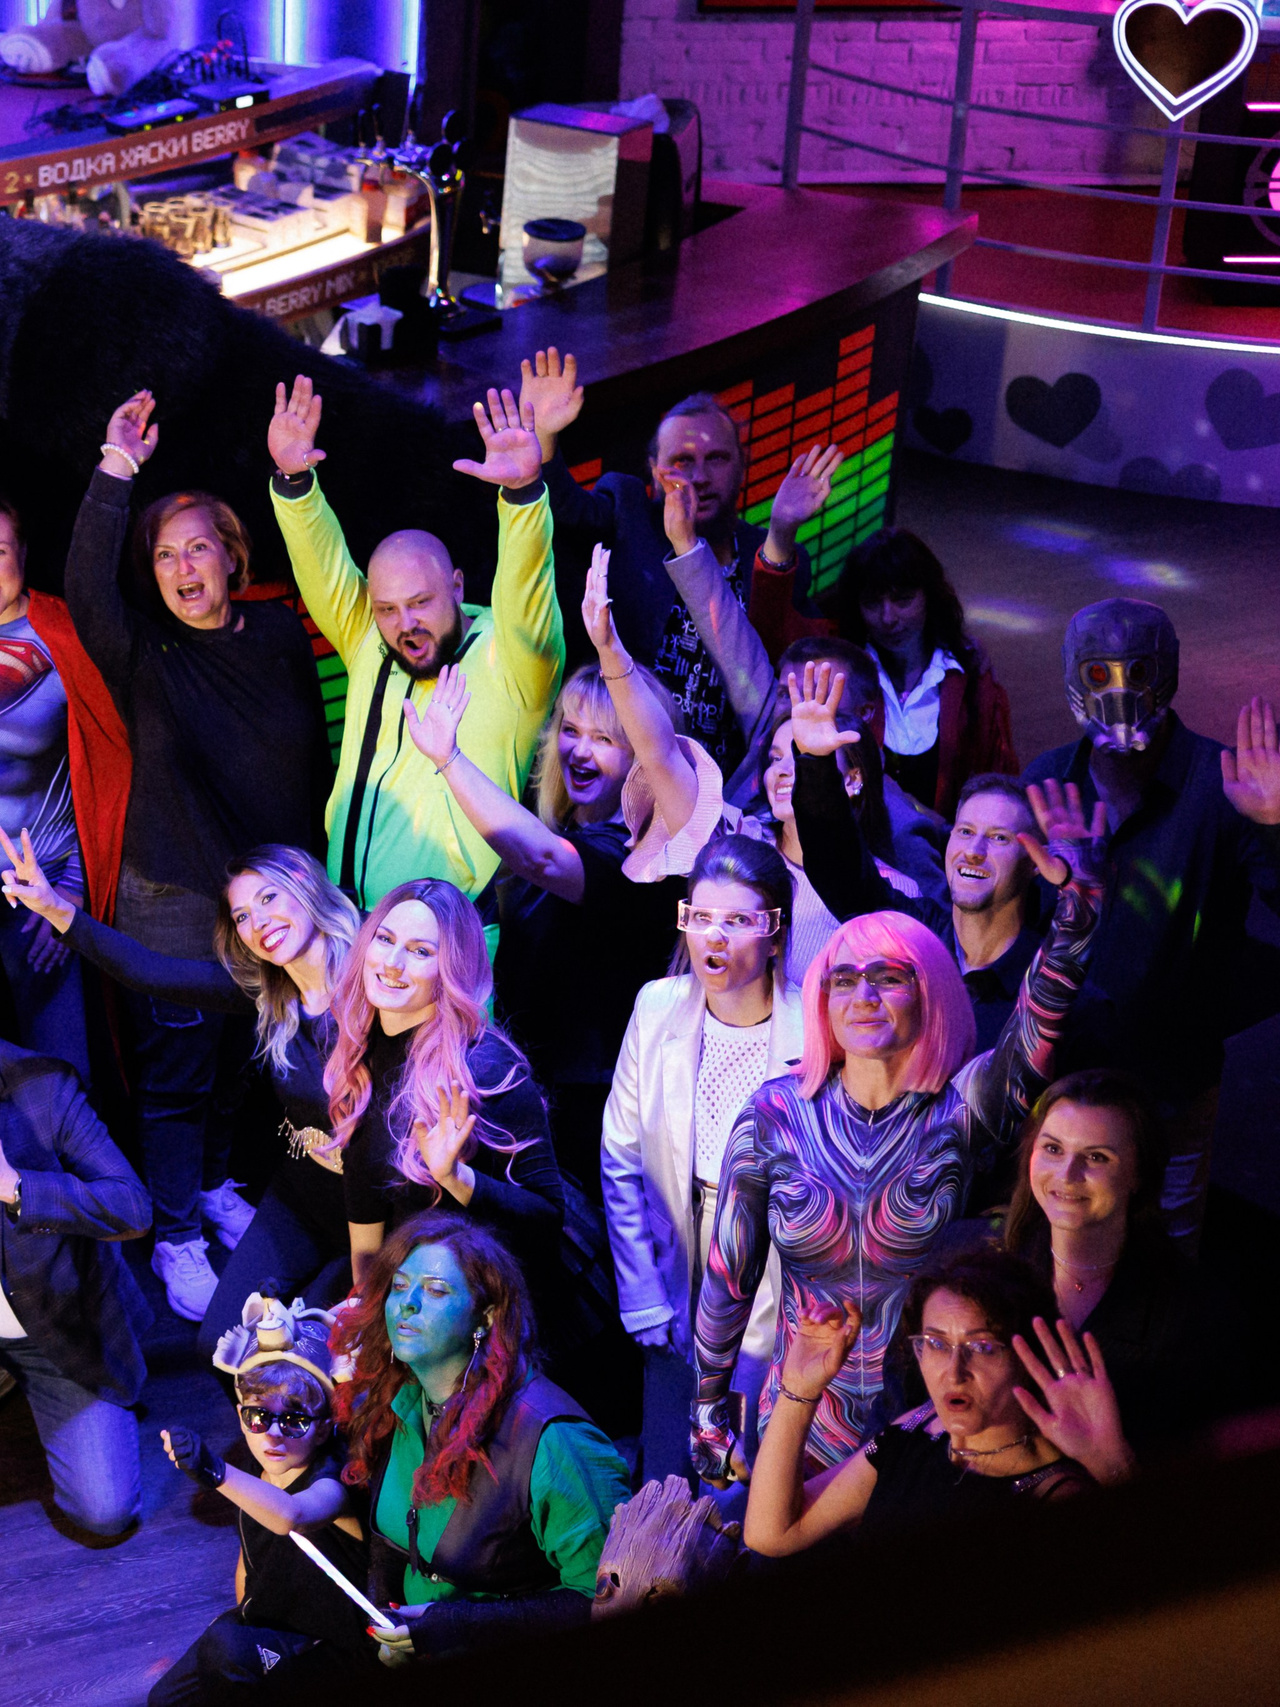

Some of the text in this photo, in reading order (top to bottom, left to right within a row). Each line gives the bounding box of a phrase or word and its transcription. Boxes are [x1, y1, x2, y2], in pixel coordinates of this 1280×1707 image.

[37, 152, 117, 187] ВОДКА
[120, 137, 189, 171] ХАСКИ
[191, 118, 251, 153] BERRY
[264, 282, 323, 317] BERRY
